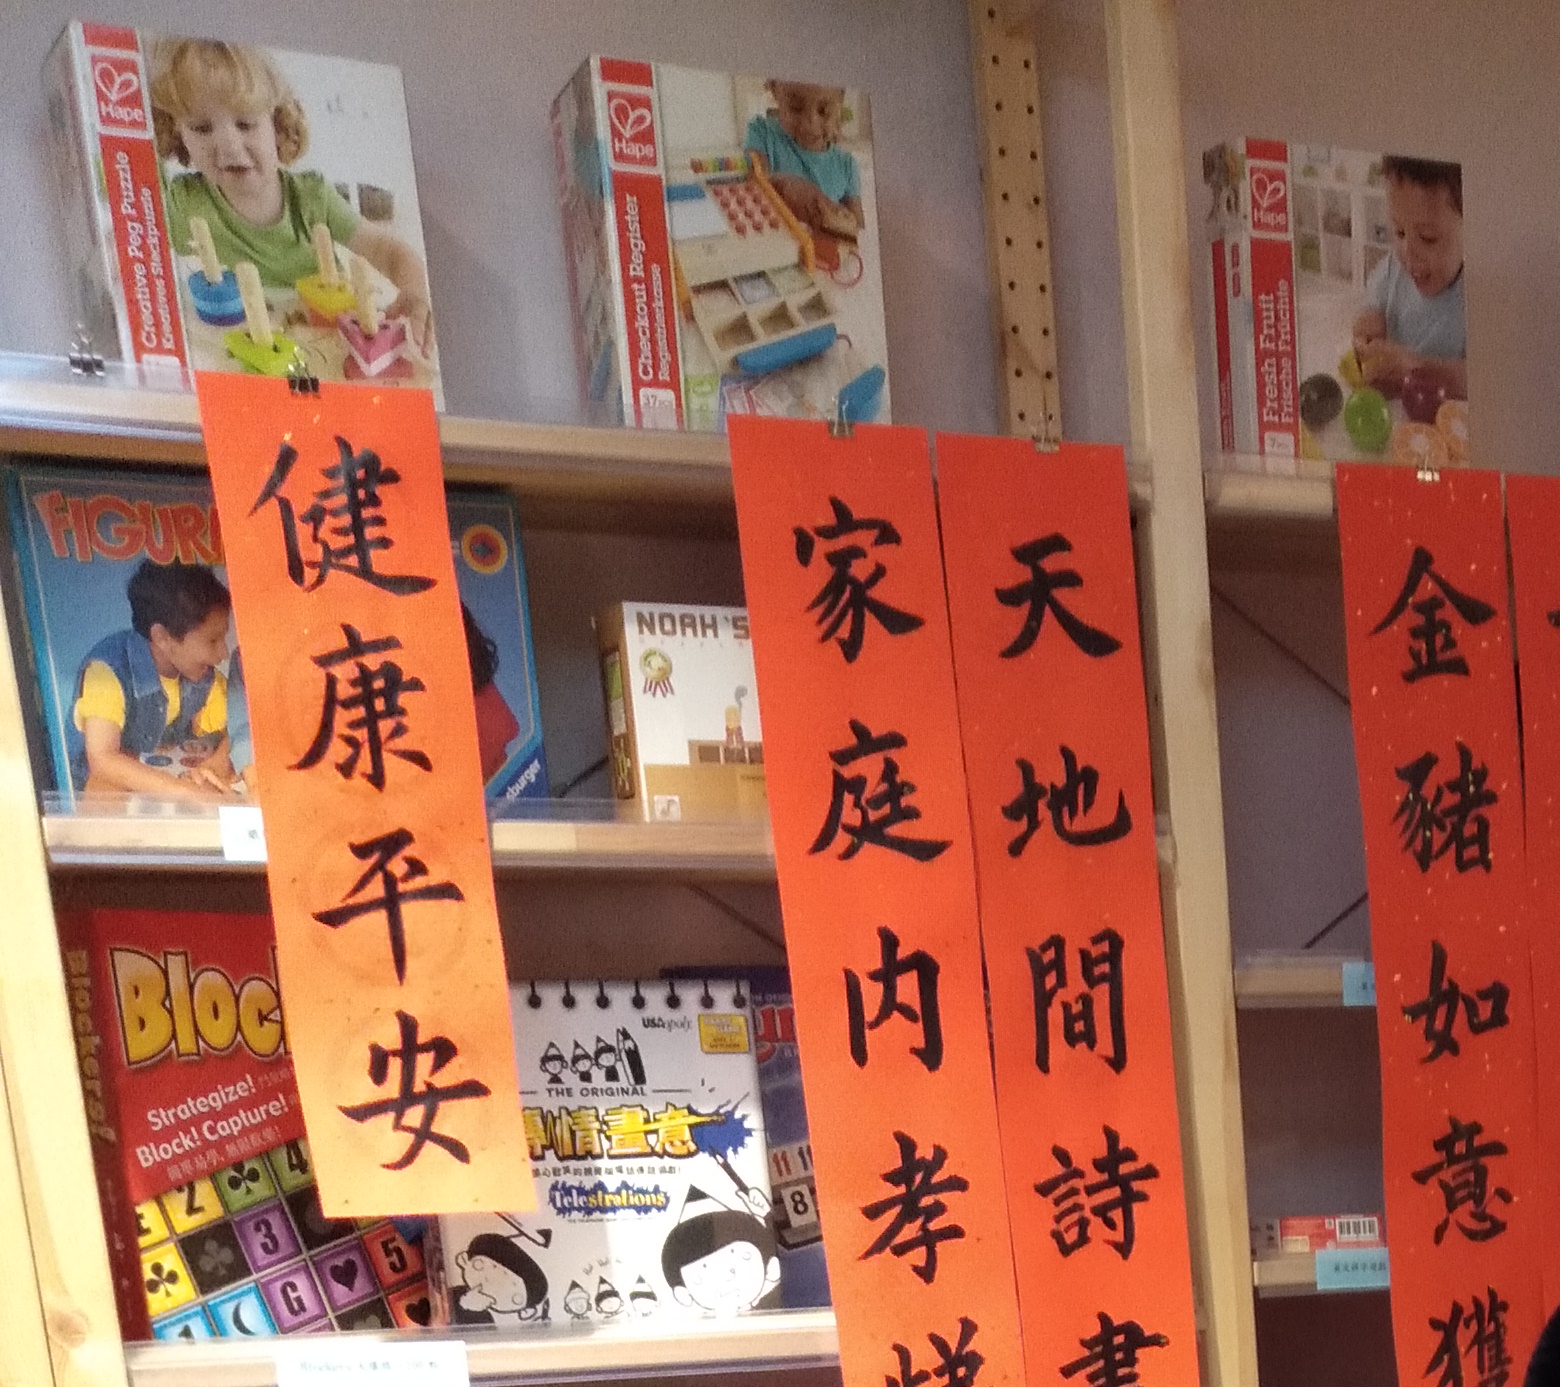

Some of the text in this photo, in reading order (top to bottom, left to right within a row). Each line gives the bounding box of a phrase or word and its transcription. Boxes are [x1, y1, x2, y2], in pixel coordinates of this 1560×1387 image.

[100, 102, 145, 124] Hape
[614, 137, 655, 159] Hape
[1253, 207, 1288, 226] Hape
[116, 151, 158, 349] Creative Peg Puzzle
[625, 193, 654, 382] Checkout Register
[1260, 292, 1280, 424] Fresh Fruit
[249, 436, 492, 1171] 健康平安
[146, 1072, 256, 1133] Strategize!
[545, 1086, 648, 1098] THE ORIGINAL
[135, 1092, 290, 1169] Block! Capture!
[552, 1186, 667, 1210] Telestrations
[788, 1189, 809, 1216] 8
[252, 1217, 281, 1257] 3
[380, 1235, 409, 1275] 5
[280, 1279, 308, 1317] G
